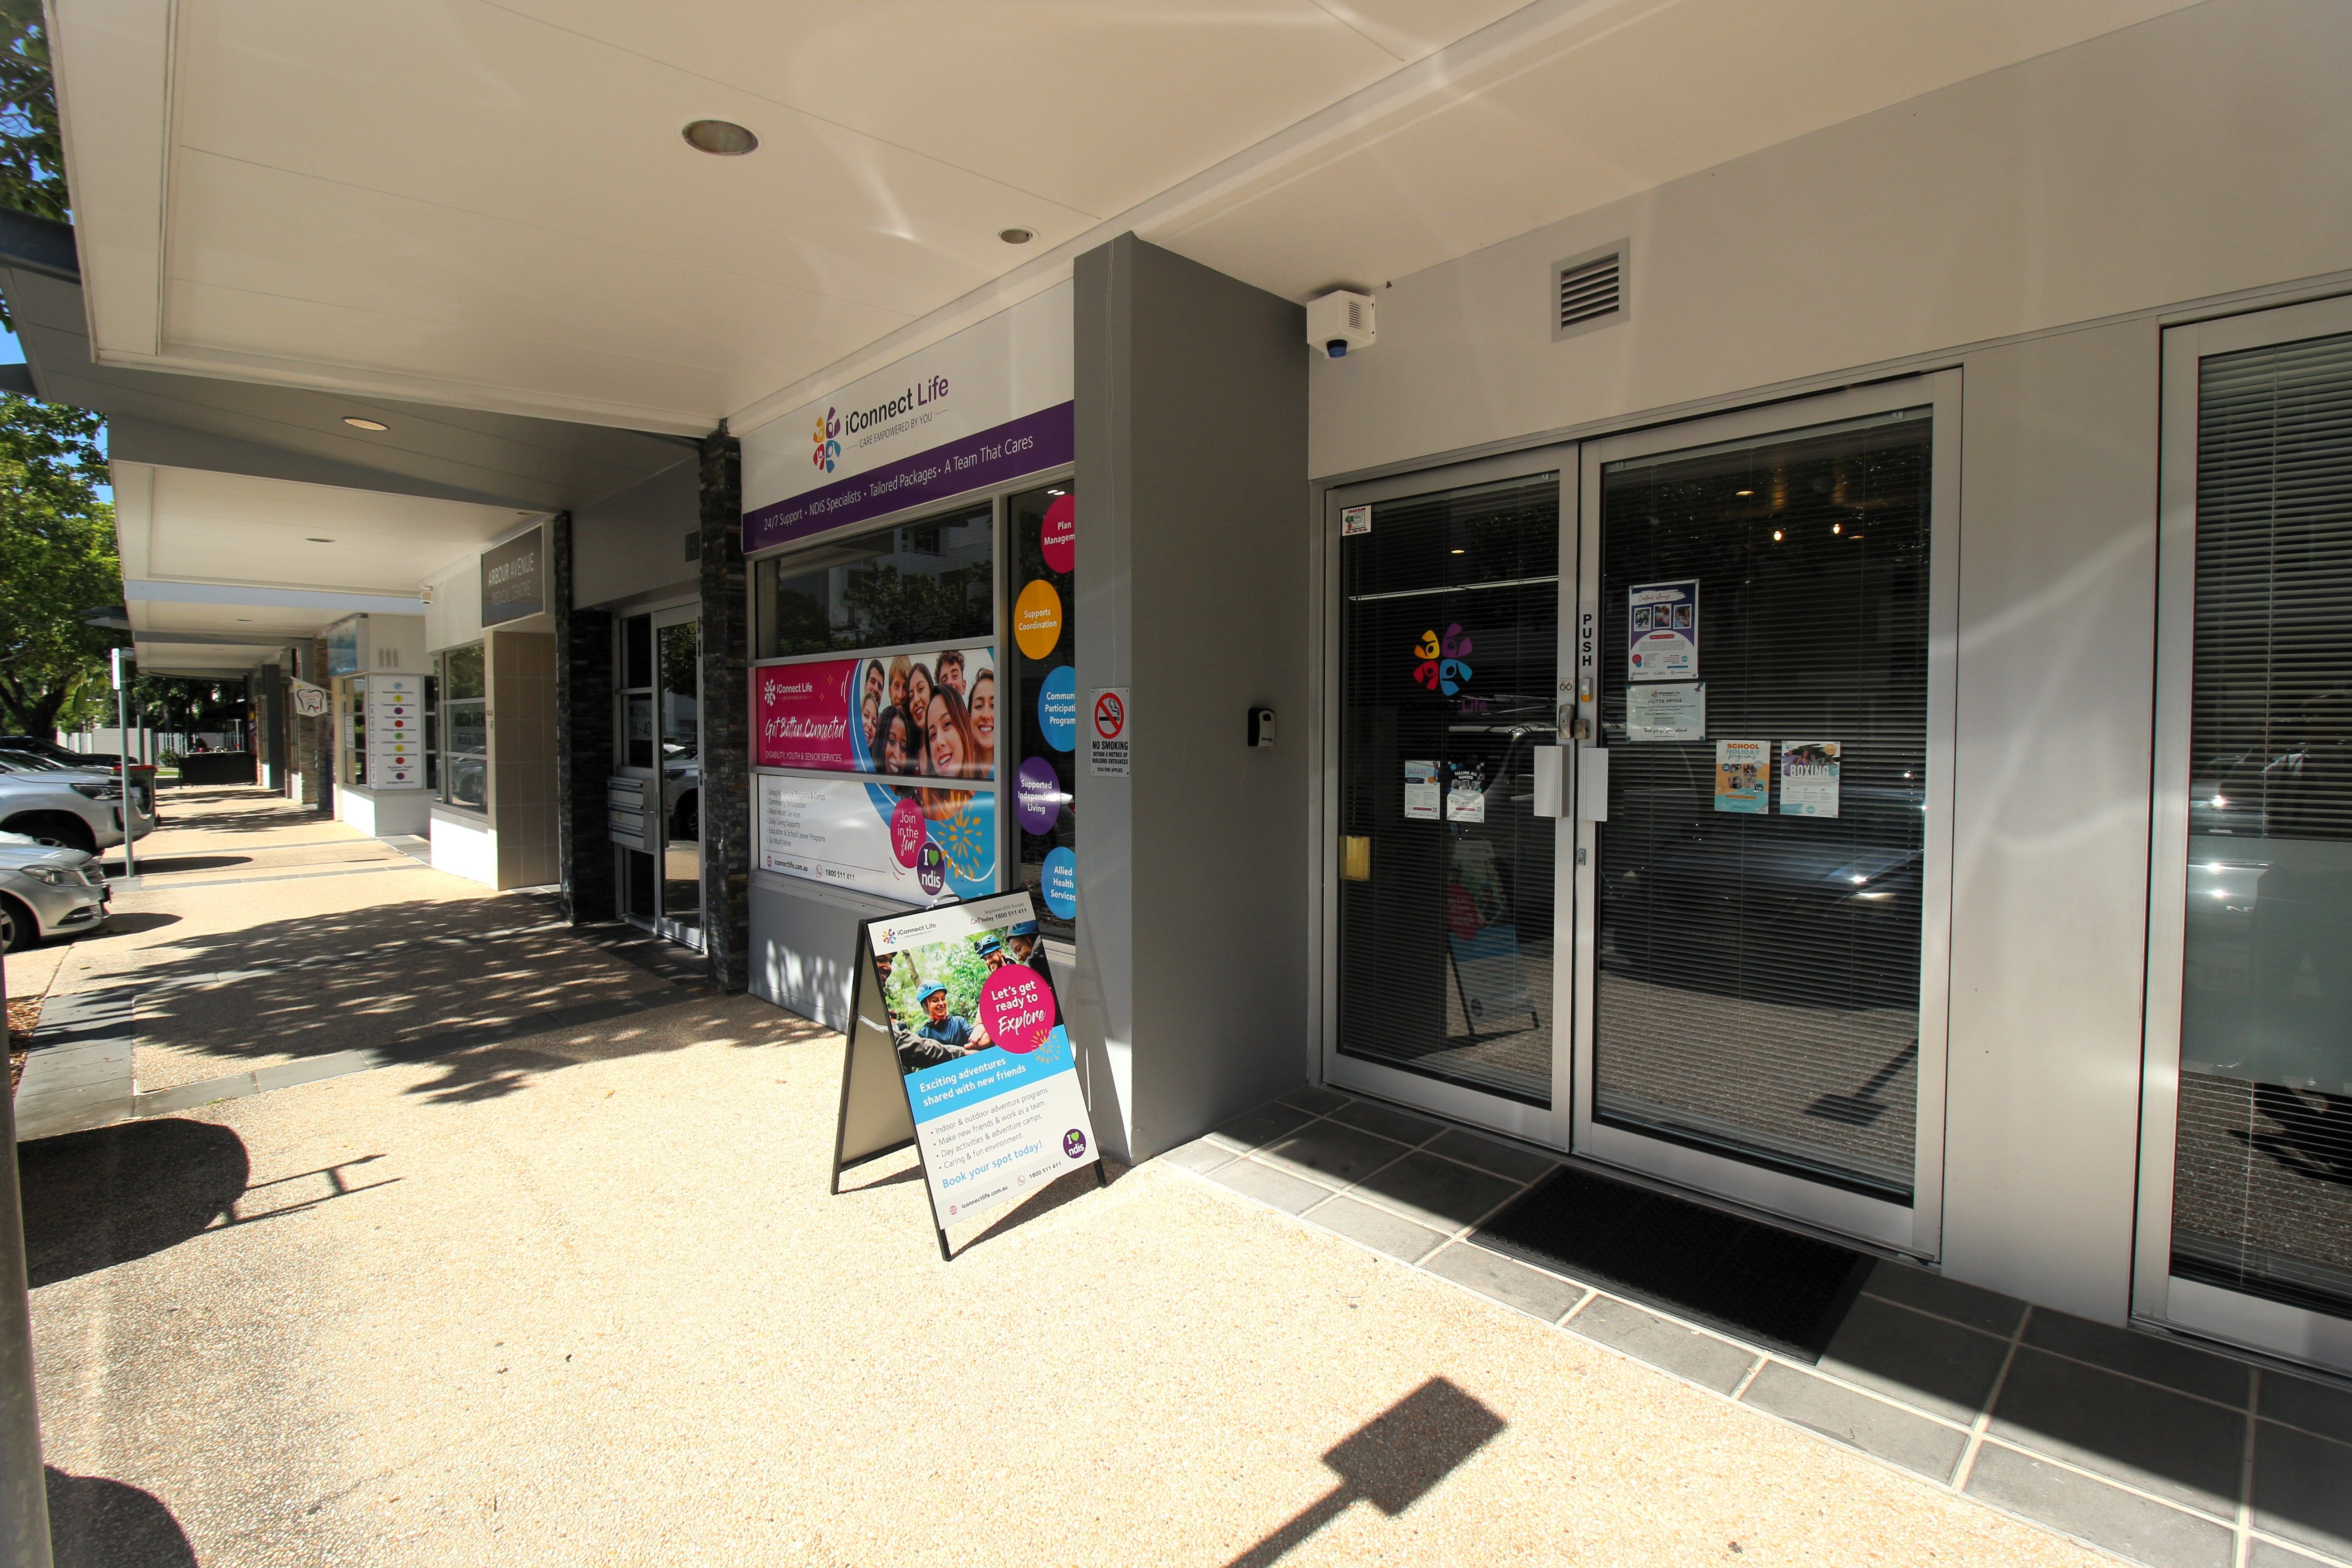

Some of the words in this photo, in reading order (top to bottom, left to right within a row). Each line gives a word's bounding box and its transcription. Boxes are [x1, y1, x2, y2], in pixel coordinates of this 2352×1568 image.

[846, 388, 913, 436] iConnect
[918, 375, 949, 406] Life
[859, 435, 872, 447] CARE
[874, 421, 909, 443] EMPOWERED
[911, 416, 918, 428] BY
[920, 412, 932, 425] YOU
[764, 515, 779, 530] 24/7
[779, 509, 803, 526] Support
[809, 500, 825, 516] NDIS
[827, 491, 861, 513] Specialists
[869, 475, 897, 497] Tailored
[900, 467, 937, 488] Packages
[945, 460, 951, 474] A
[954, 454, 977, 470] Team
[980, 444, 1002, 462] That
[1005, 436, 1033, 454] Cares
[1058, 521, 1071, 530] Plan
[1044, 534, 1075, 545] Managem
[488, 563, 510, 587] ARBOUR
[510, 553, 534, 578] AVENUE
[1024, 608, 1051, 619] Supports
[1019, 619, 1057, 631] Coordination
[1582, 614, 1592, 666] PUSH
[777, 683, 801, 693] iConnect
[802, 682, 813, 692] Life
[1559, 681, 1573, 691] 66
[1045, 703, 1076, 714] Participati
[1461, 700, 1488, 712] Life
[1050, 716, 1076, 726] Program
[765, 716, 781, 743] Get
[780, 716, 802, 739] Better
[804, 716, 847, 740] Connected
[1093, 741, 1100, 750] NO
[1102, 741, 1128, 750] SMOKING
[765, 751, 786, 760] DISABILITY,
[804, 753, 821, 761] SENIOR
[821, 754, 842, 762] SERVICES
[1728, 754, 1756, 762] programs
[1790, 764, 1829, 777] BOXING
[1021, 779, 1052, 790] Supported
[768, 789, 778, 797] Group
[813, 793, 826, 801] Camps
[1018, 791, 1055, 802] Independ
[1028, 804, 1045, 814] Living
[769, 817, 777, 826] Daily
[777, 818, 786, 828] Living
[786, 820, 800, 828] Supports
[900, 811, 916, 824] Join
[769, 827, 784, 835] Education
[787, 829, 798, 838] School
[798, 831, 809, 839] Leaver
[809, 833, 826, 843] Programs
[897, 824, 904, 836] in
[906, 825, 919, 838] the
[901, 834, 916, 856] fun
[924, 848, 929, 866] I
[774, 858, 808, 871] iconnectlife.com.au
[825, 869, 837, 877] 1800
[837, 871, 845, 879] 511
[846, 872, 855, 881] 411
[1054, 866, 1073, 876] Allied
[921, 870, 941, 888] ndis
[1054, 877, 1073, 888] Health
[1051, 889, 1076, 901] Services
[897, 925, 925, 936] iConnect
[991, 985, 1017, 1000] Let's
[1019, 980, 1036, 995] get
[995, 996, 1024, 1012] ready
[1026, 994, 1038, 1003] to
[998, 1009, 1046, 1036] Explore
[919, 1074, 957, 1093] Exciting
[958, 1058, 1006, 1080] adventures
[923, 1088, 954, 1107] shared
[955, 1081, 975, 1096] with
[977, 1075, 995, 1088] new
[996, 1064, 1026, 1081] friends
[935, 1122, 956, 1134] Indoor
[964, 1109, 989, 1123] outdoor
[990, 1098, 1020, 1114] adventure
[1021, 1087, 1050, 1103] programs.
[938, 1135, 957, 1146] Make
[957, 1129, 971, 1138] new
[972, 1120, 994, 1133] friends
[1001, 1110, 1017, 1122] work
[1030, 1100, 1047, 1111] team.
[941, 1148, 954, 1158] Day
[956, 1136, 984, 1152] activities
[991, 1121, 1022, 1136] adventure
[1022, 1113, 1043, 1125] camps.
[1067, 1134, 1072, 1145] I
[944, 1156, 965, 1169] Caring
[972, 1147, 984, 1158] fun
[985, 1132, 1024, 1152] environment.
[1068, 1142, 1085, 1156] ndis
[942, 1171, 967, 1189] Book
[969, 1162, 990, 1181] your
[992, 1153, 1013, 1169] spot
[1014, 1139, 1043, 1158] today!
[961, 1185, 1008, 1209] iconnectlife.com.au
[1029, 1170, 1042, 1179] 1800
[1042, 1166, 1052, 1174] 511
[1052, 1161, 1062, 1170] 411
